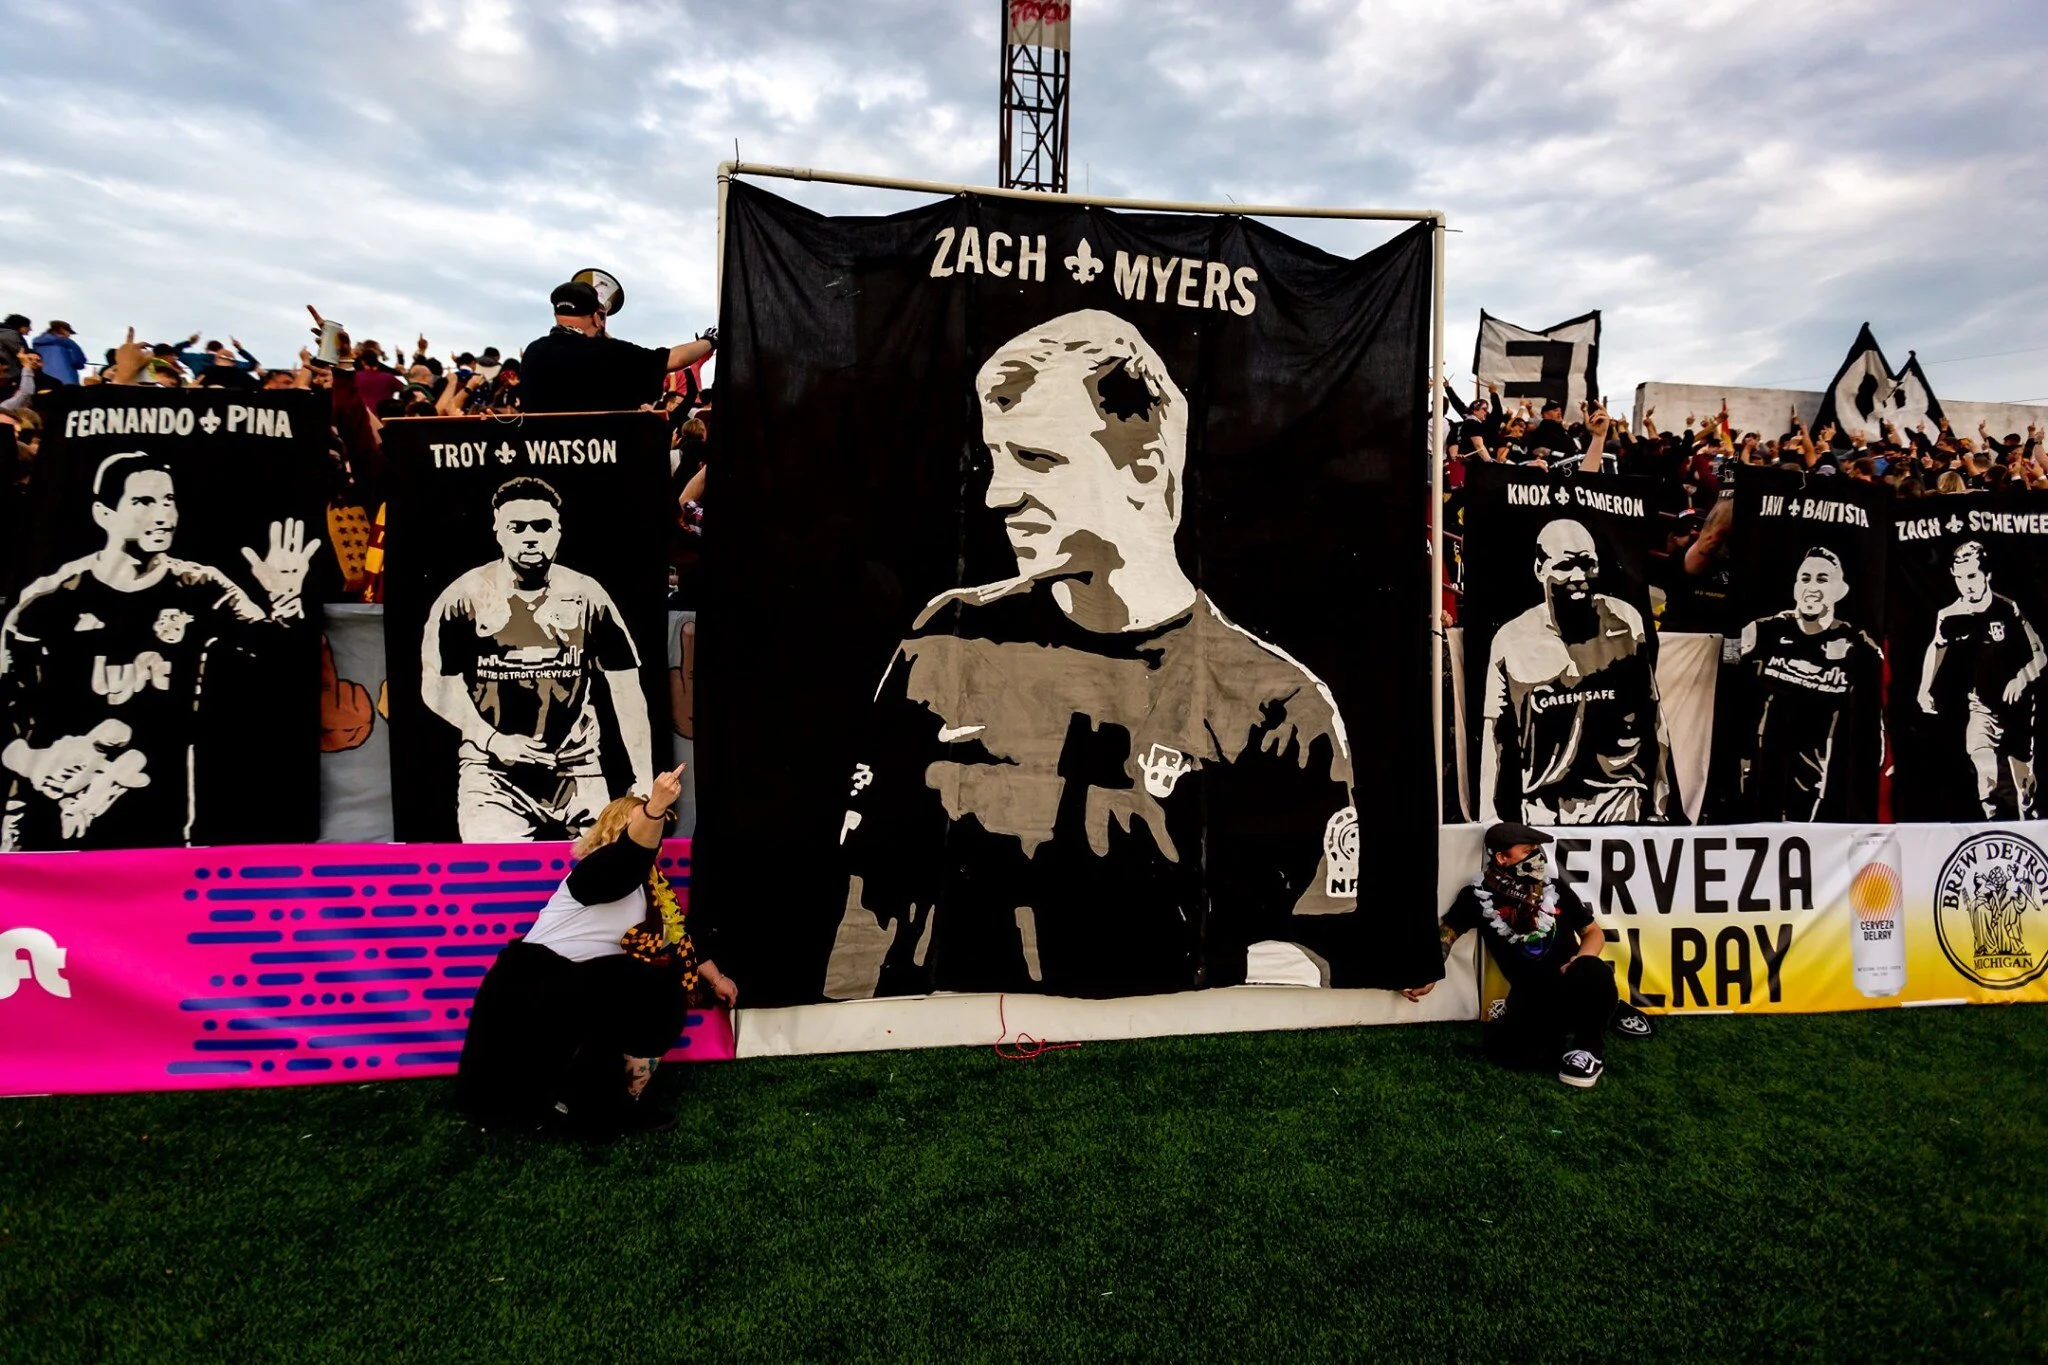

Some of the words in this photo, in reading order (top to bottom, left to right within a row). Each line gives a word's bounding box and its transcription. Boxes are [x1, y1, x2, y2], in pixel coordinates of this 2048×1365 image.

[930, 227, 1047, 283] ZACH
[1114, 250, 1259, 317] MYERS
[65, 407, 196, 438] FERNANDO
[226, 404, 294, 439] PINA
[429, 441, 488, 469] TROY
[524, 438, 618, 465] WATSON
[1507, 483, 1551, 507] KNOX
[1574, 486, 1645, 518] CAMERON
[1759, 495, 1785, 517] JAVI
[1802, 498, 1870, 529] BAUTISTA
[1895, 517, 1942, 541] ZACH
[91, 650, 173, 705] lyft
[535, 668, 562, 679] CHEVY
[1539, 692, 1583, 709] GREEN
[1585, 689, 1616, 702] SAFE
[1554, 836, 1814, 914] ERVEZA
[1942, 846, 1978, 911] BREW
[1860, 919, 1895, 931] CERVEZA
[1863, 930, 1892, 941] DELRAY
[1973, 956, 2034, 970] MICHIGAN
